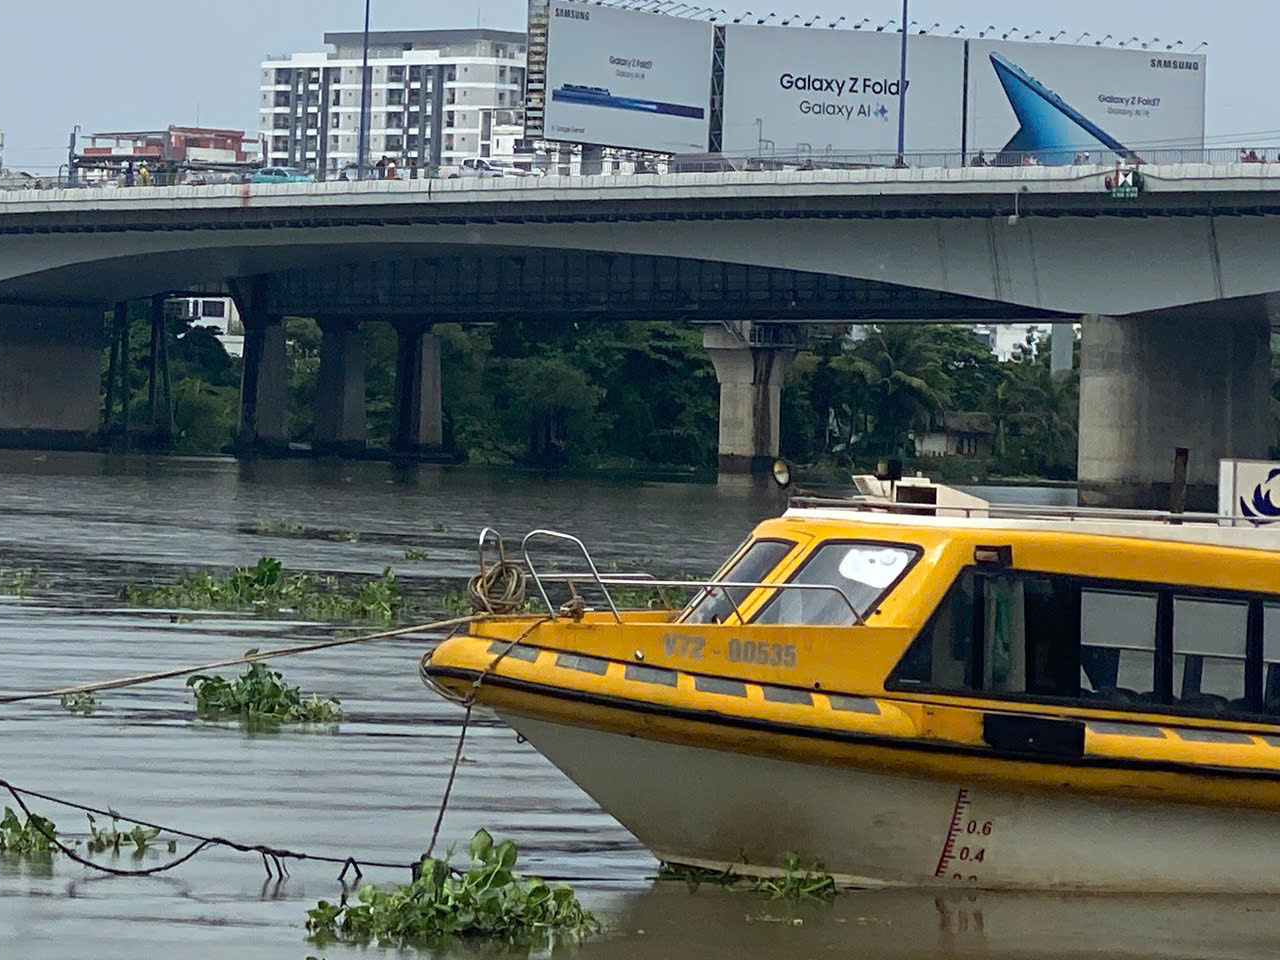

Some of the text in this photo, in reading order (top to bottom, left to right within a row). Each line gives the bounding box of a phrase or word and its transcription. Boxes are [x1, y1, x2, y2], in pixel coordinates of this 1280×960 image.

[555, 8, 590, 21] SAMSUNG
[1150, 58, 1199, 71] SAMSUNG
[780, 73, 845, 96] Galaxy
[849, 77, 859, 94] Z
[1098, 93, 1161, 107] Galaxy Z Fold7
[799, 100, 871, 120] Galaxy AI
[967, 820, 993, 836] 0.6
[959, 846, 985, 863] 0.4
